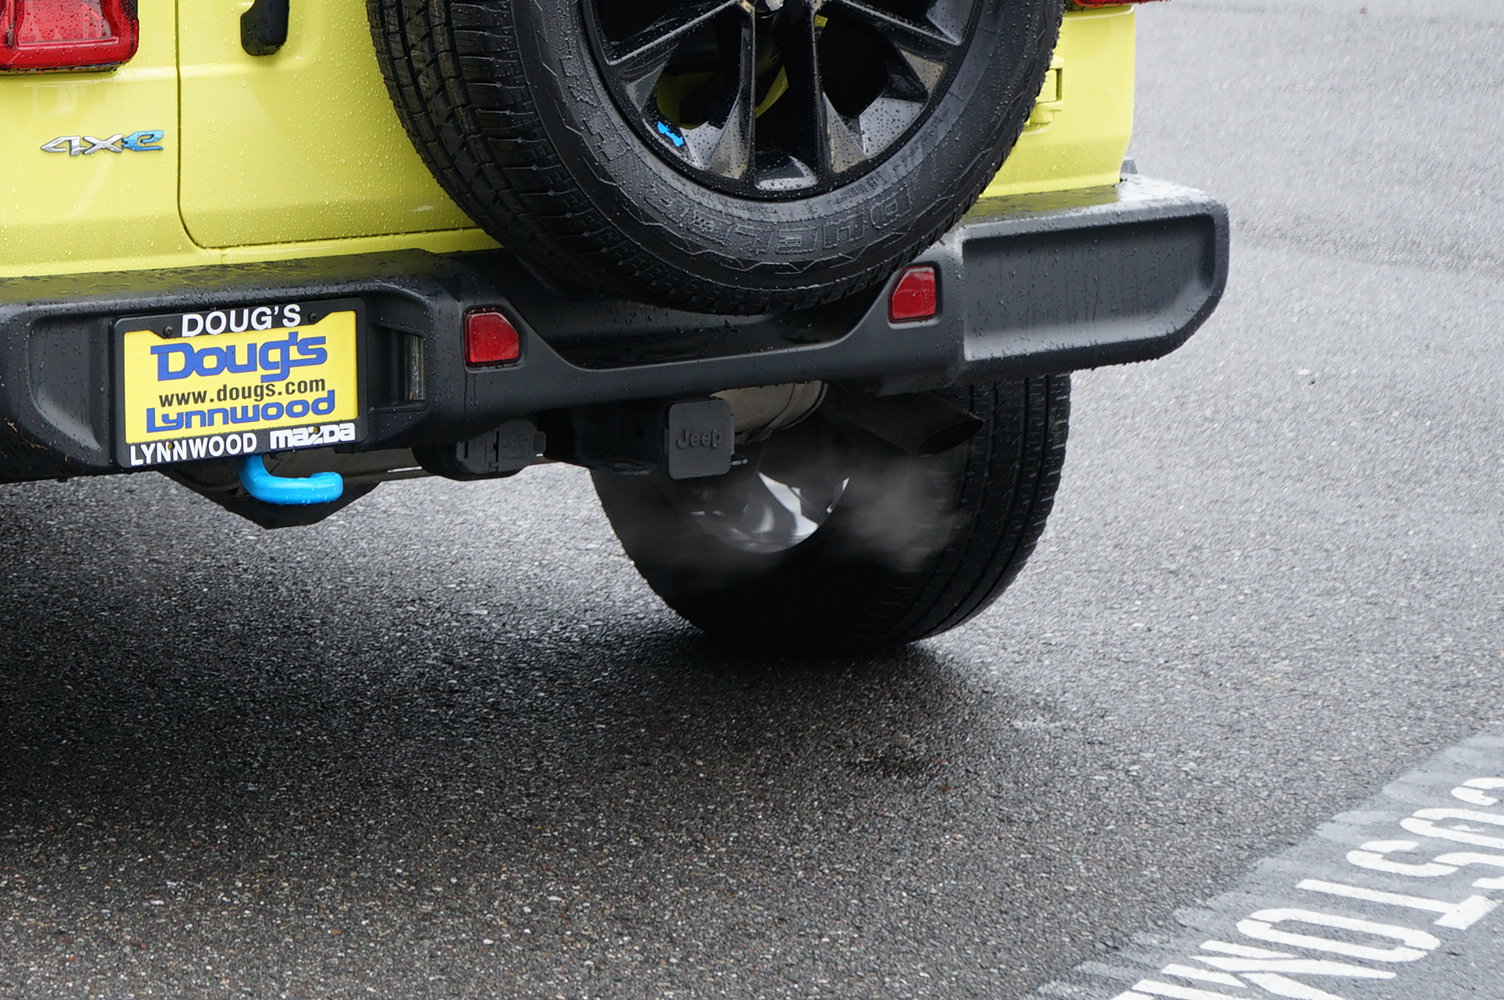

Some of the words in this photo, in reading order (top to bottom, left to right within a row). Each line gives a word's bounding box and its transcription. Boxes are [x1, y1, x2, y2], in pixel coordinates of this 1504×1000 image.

[181, 304, 301, 337] DOUG'S
[150, 331, 328, 383] Doug's
[159, 378, 326, 407] www.dougs.com
[146, 389, 335, 433] Lynnwood
[130, 432, 257, 466] LYNNWOOD
[676, 428, 720, 450] Jeep
[1110, 777, 1504, 1000] USTOM
